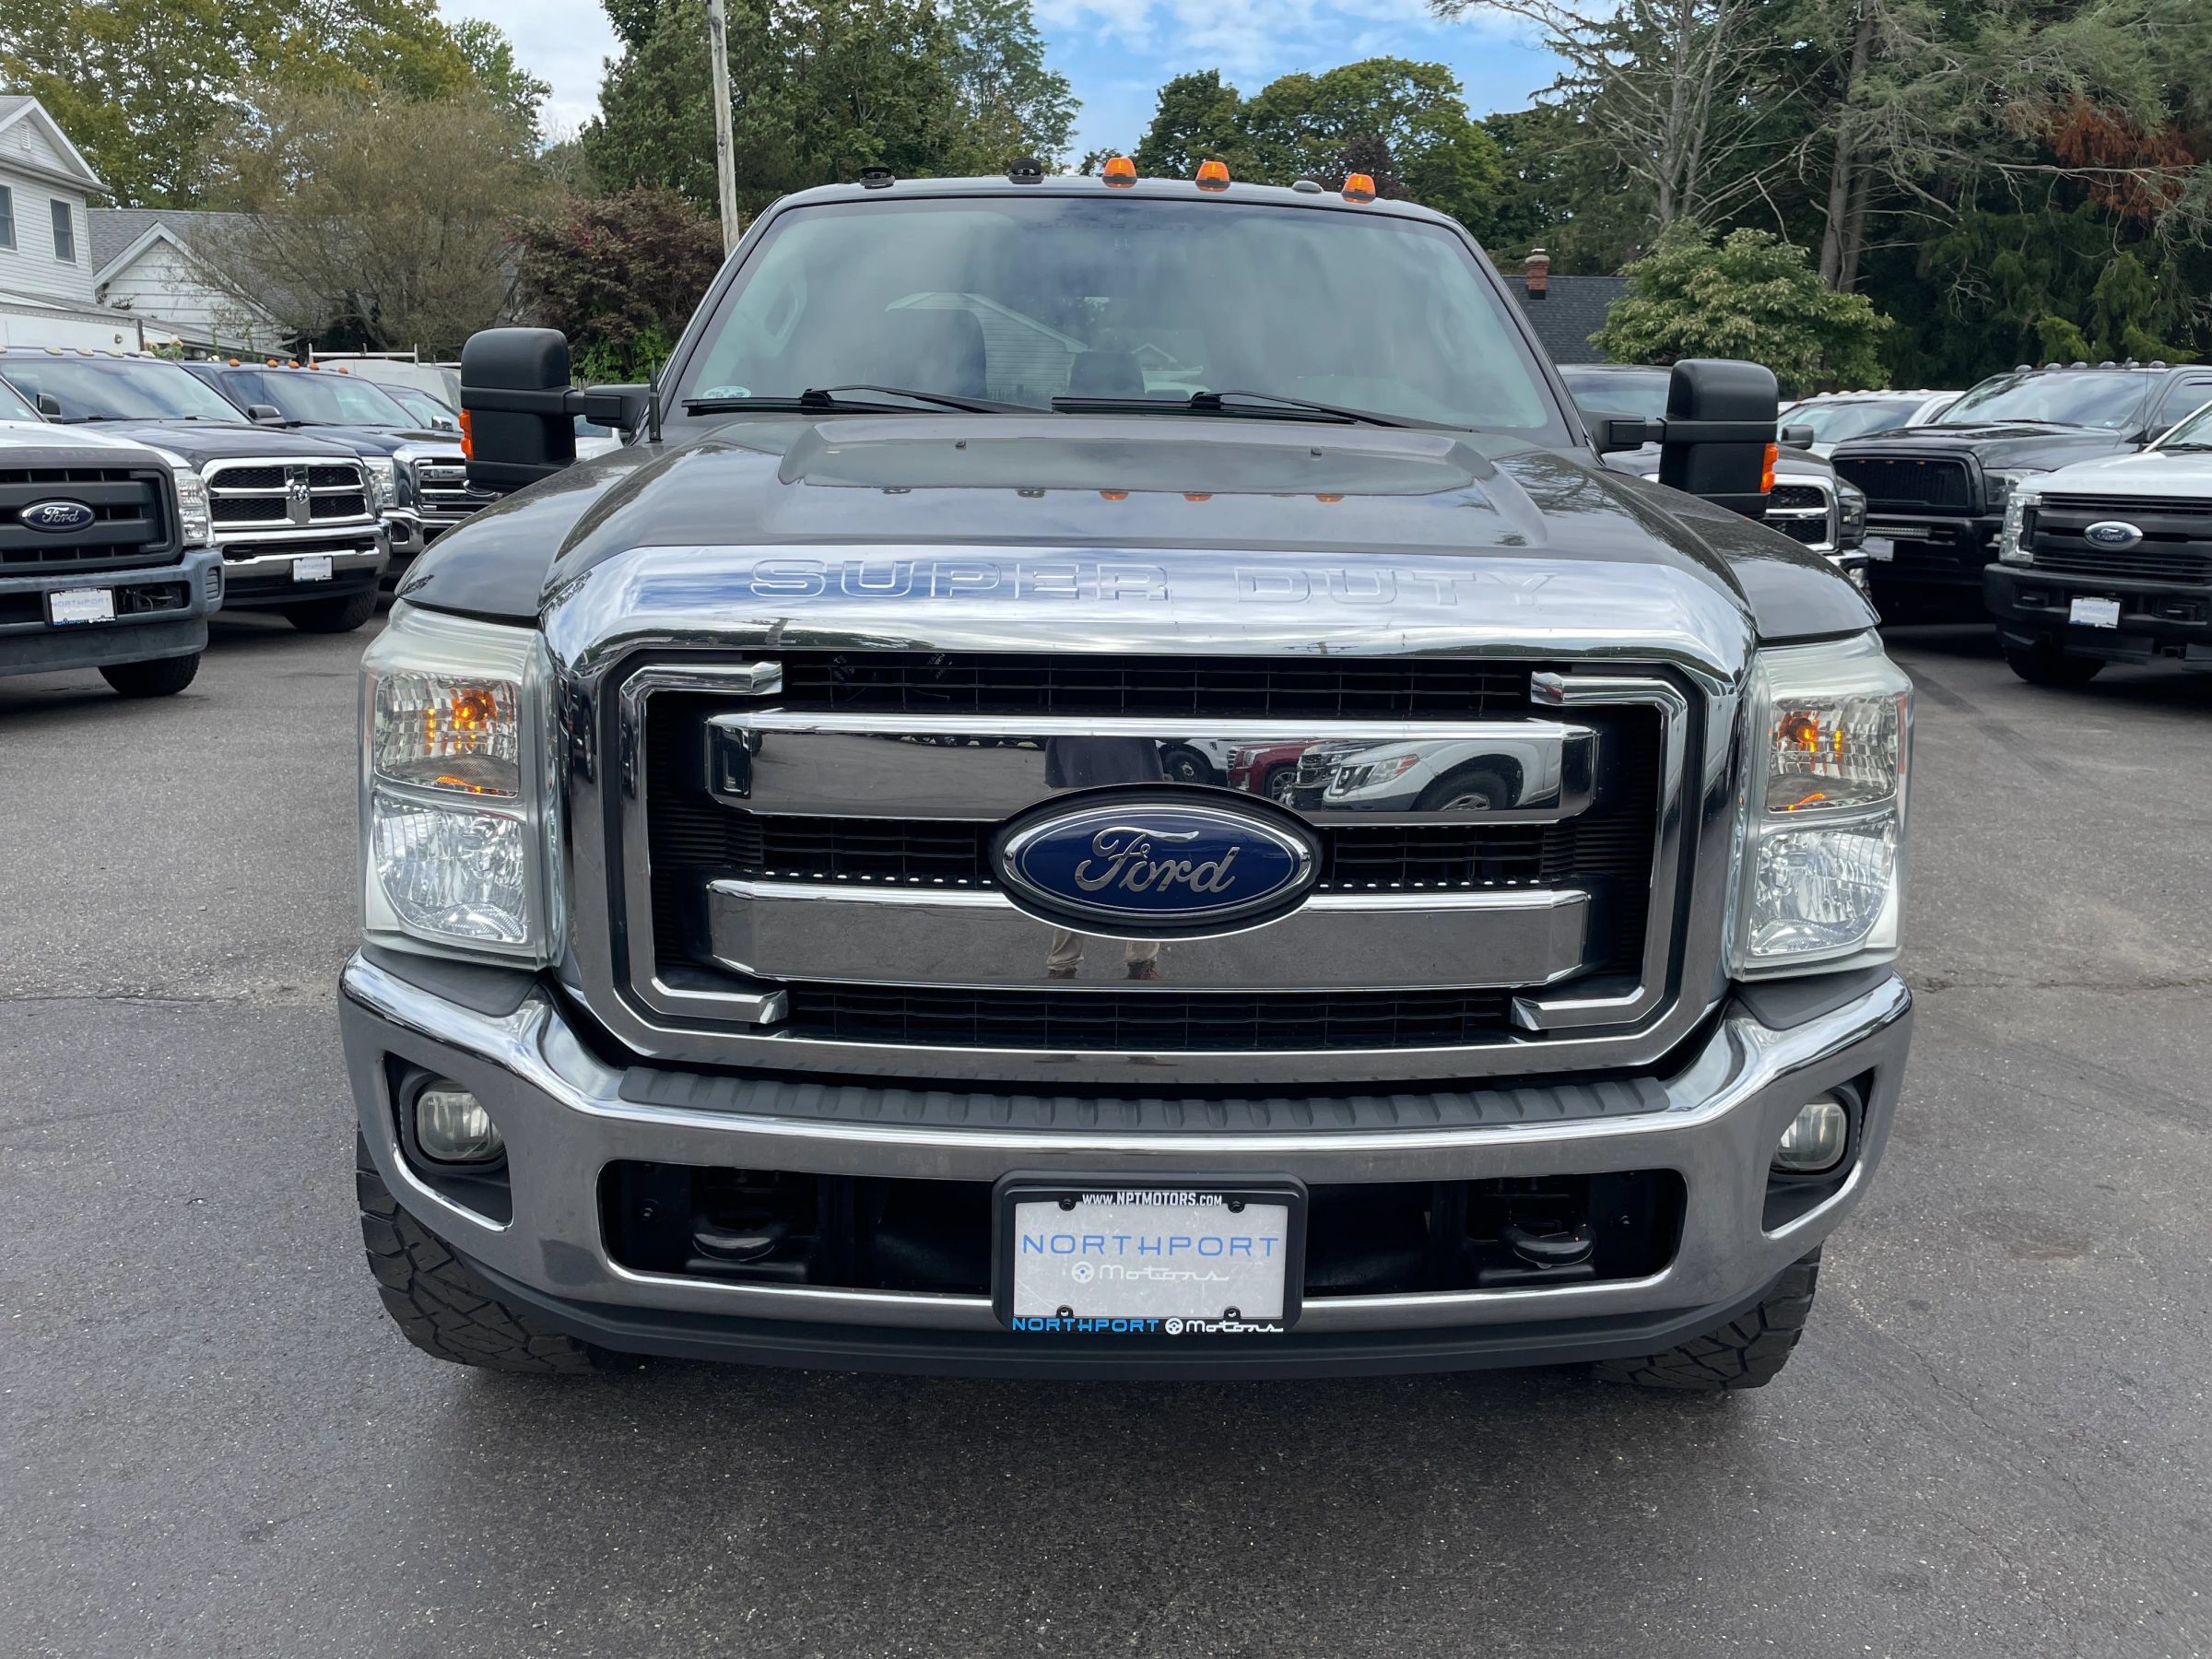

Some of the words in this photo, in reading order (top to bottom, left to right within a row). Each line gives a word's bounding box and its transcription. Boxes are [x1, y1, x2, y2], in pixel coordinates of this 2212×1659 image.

[41, 506, 79, 523] Ford
[750, 559, 1173, 602] SUPER
[1233, 566, 1558, 606] DUTY
[1074, 826, 1241, 893] Ford
[1082, 1191, 1223, 1206] WWW.NPTMOTORS.COM
[1022, 1233, 1280, 1257] NORTHPORT
[1099, 1265, 1230, 1280] Motors
[1012, 1317, 1159, 1332] NORTHPORT
[1185, 1318, 1285, 1333] Motors
